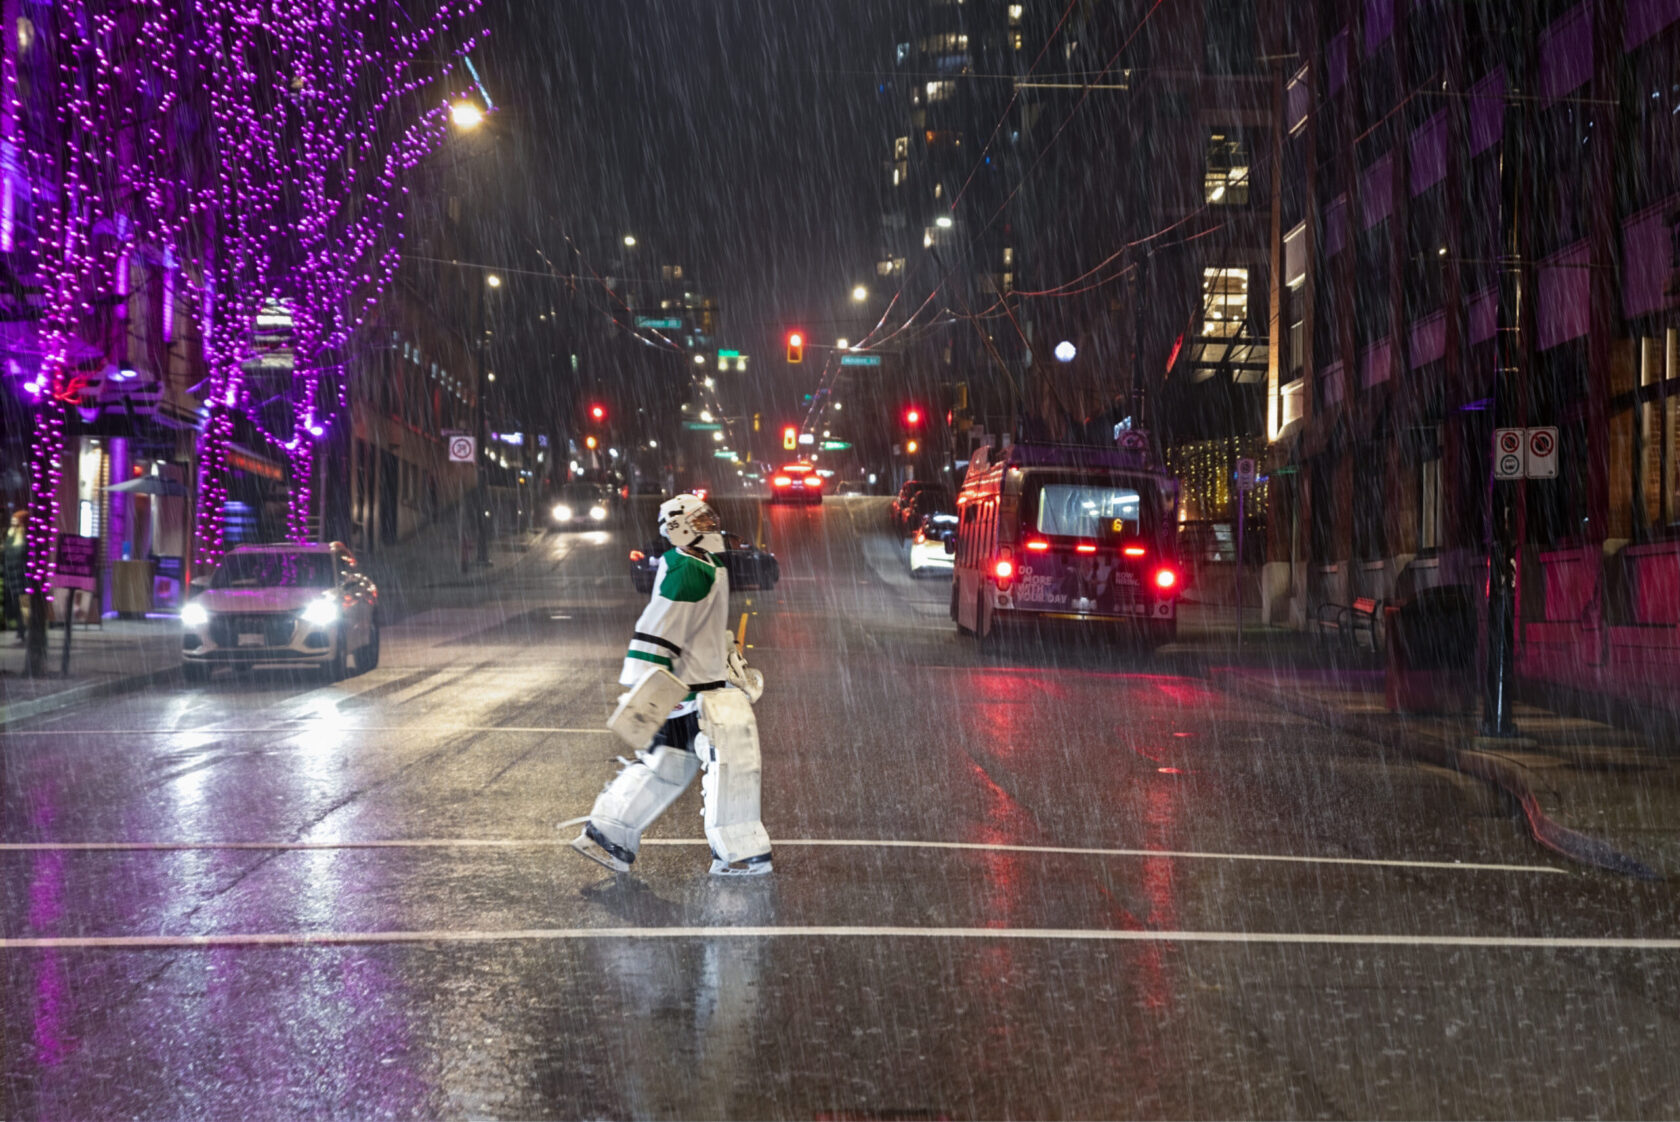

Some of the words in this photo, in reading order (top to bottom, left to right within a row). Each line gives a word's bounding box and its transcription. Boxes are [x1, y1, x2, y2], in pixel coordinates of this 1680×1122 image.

[666, 520, 680, 531] 35
[1112, 518, 1122, 532] 6
[1018, 565, 1033, 575] DO
[1022, 575, 1055, 585] MORE
[1047, 594, 1068, 604] DAY
